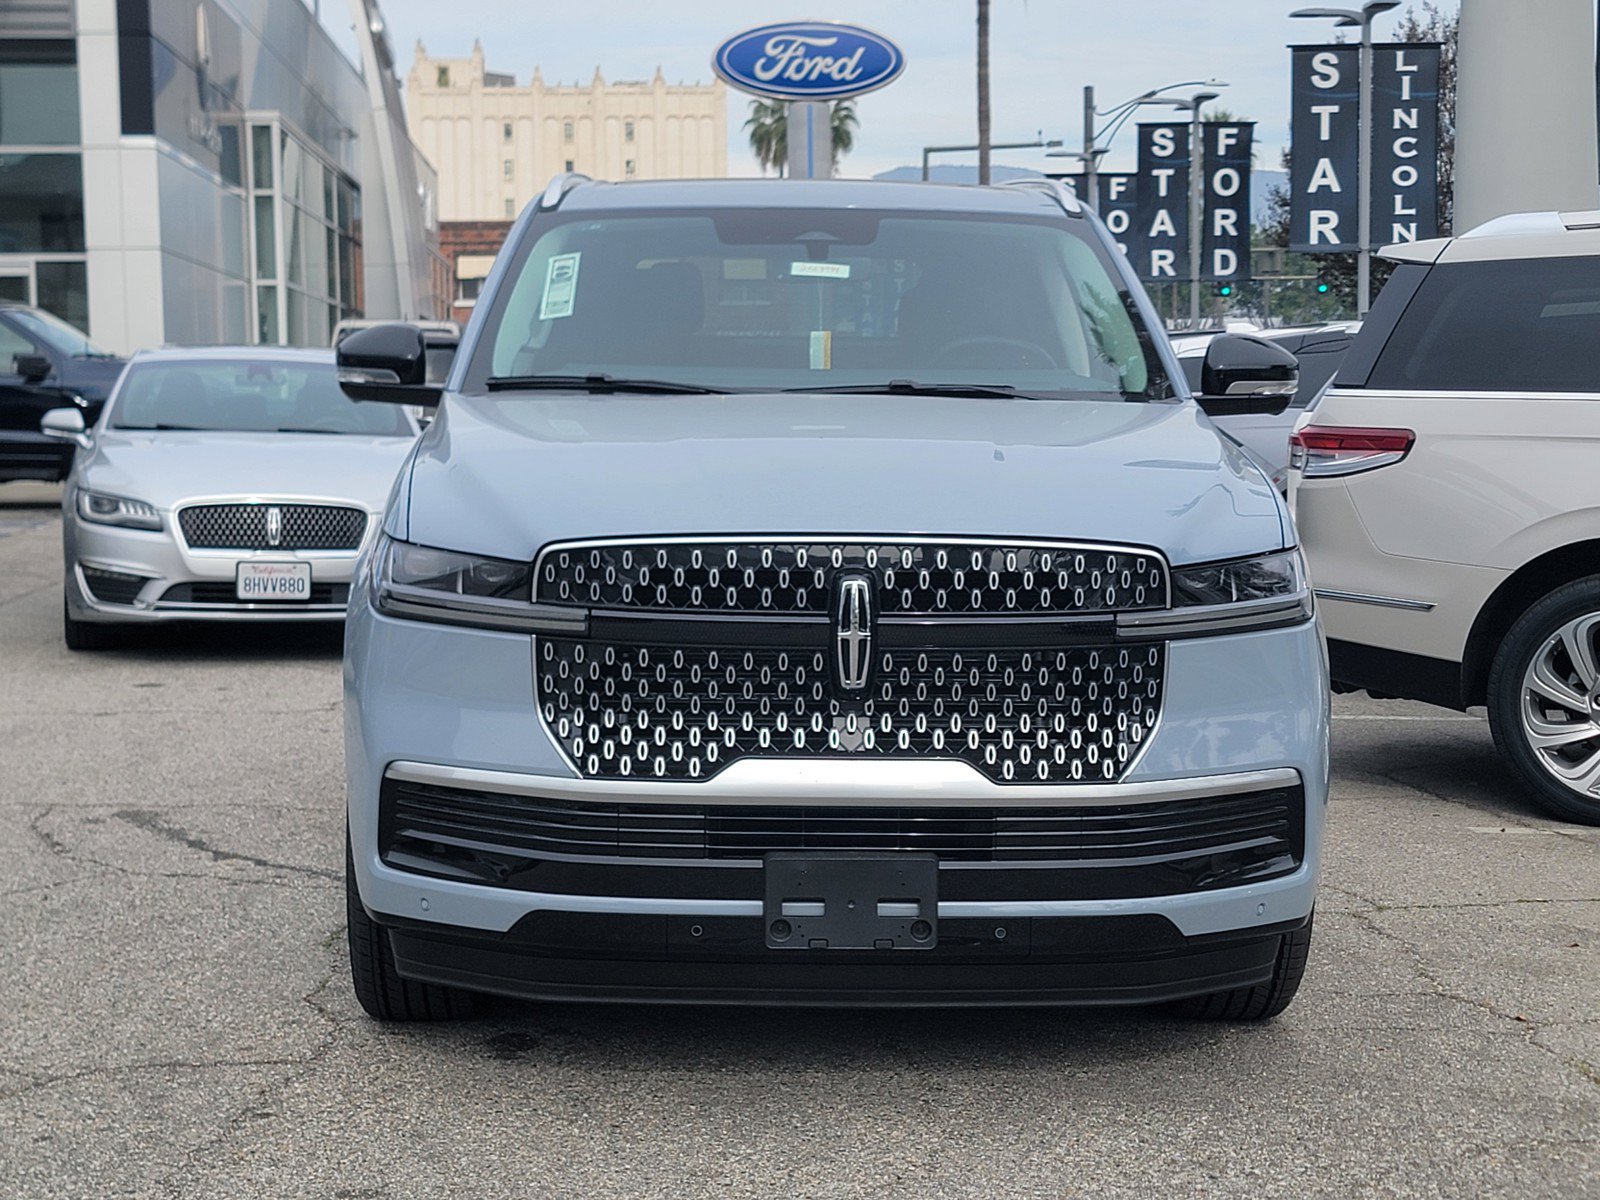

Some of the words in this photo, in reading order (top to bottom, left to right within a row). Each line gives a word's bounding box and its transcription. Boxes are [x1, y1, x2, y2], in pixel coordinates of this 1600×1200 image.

[753, 34, 866, 81] Ford
[1149, 127, 1176, 276] STAR
[1212, 127, 1240, 276] FORD
[1307, 52, 1341, 245] STAR
[1392, 50, 1419, 243] LINCOLN
[244, 577, 305, 593] 8HVV880
